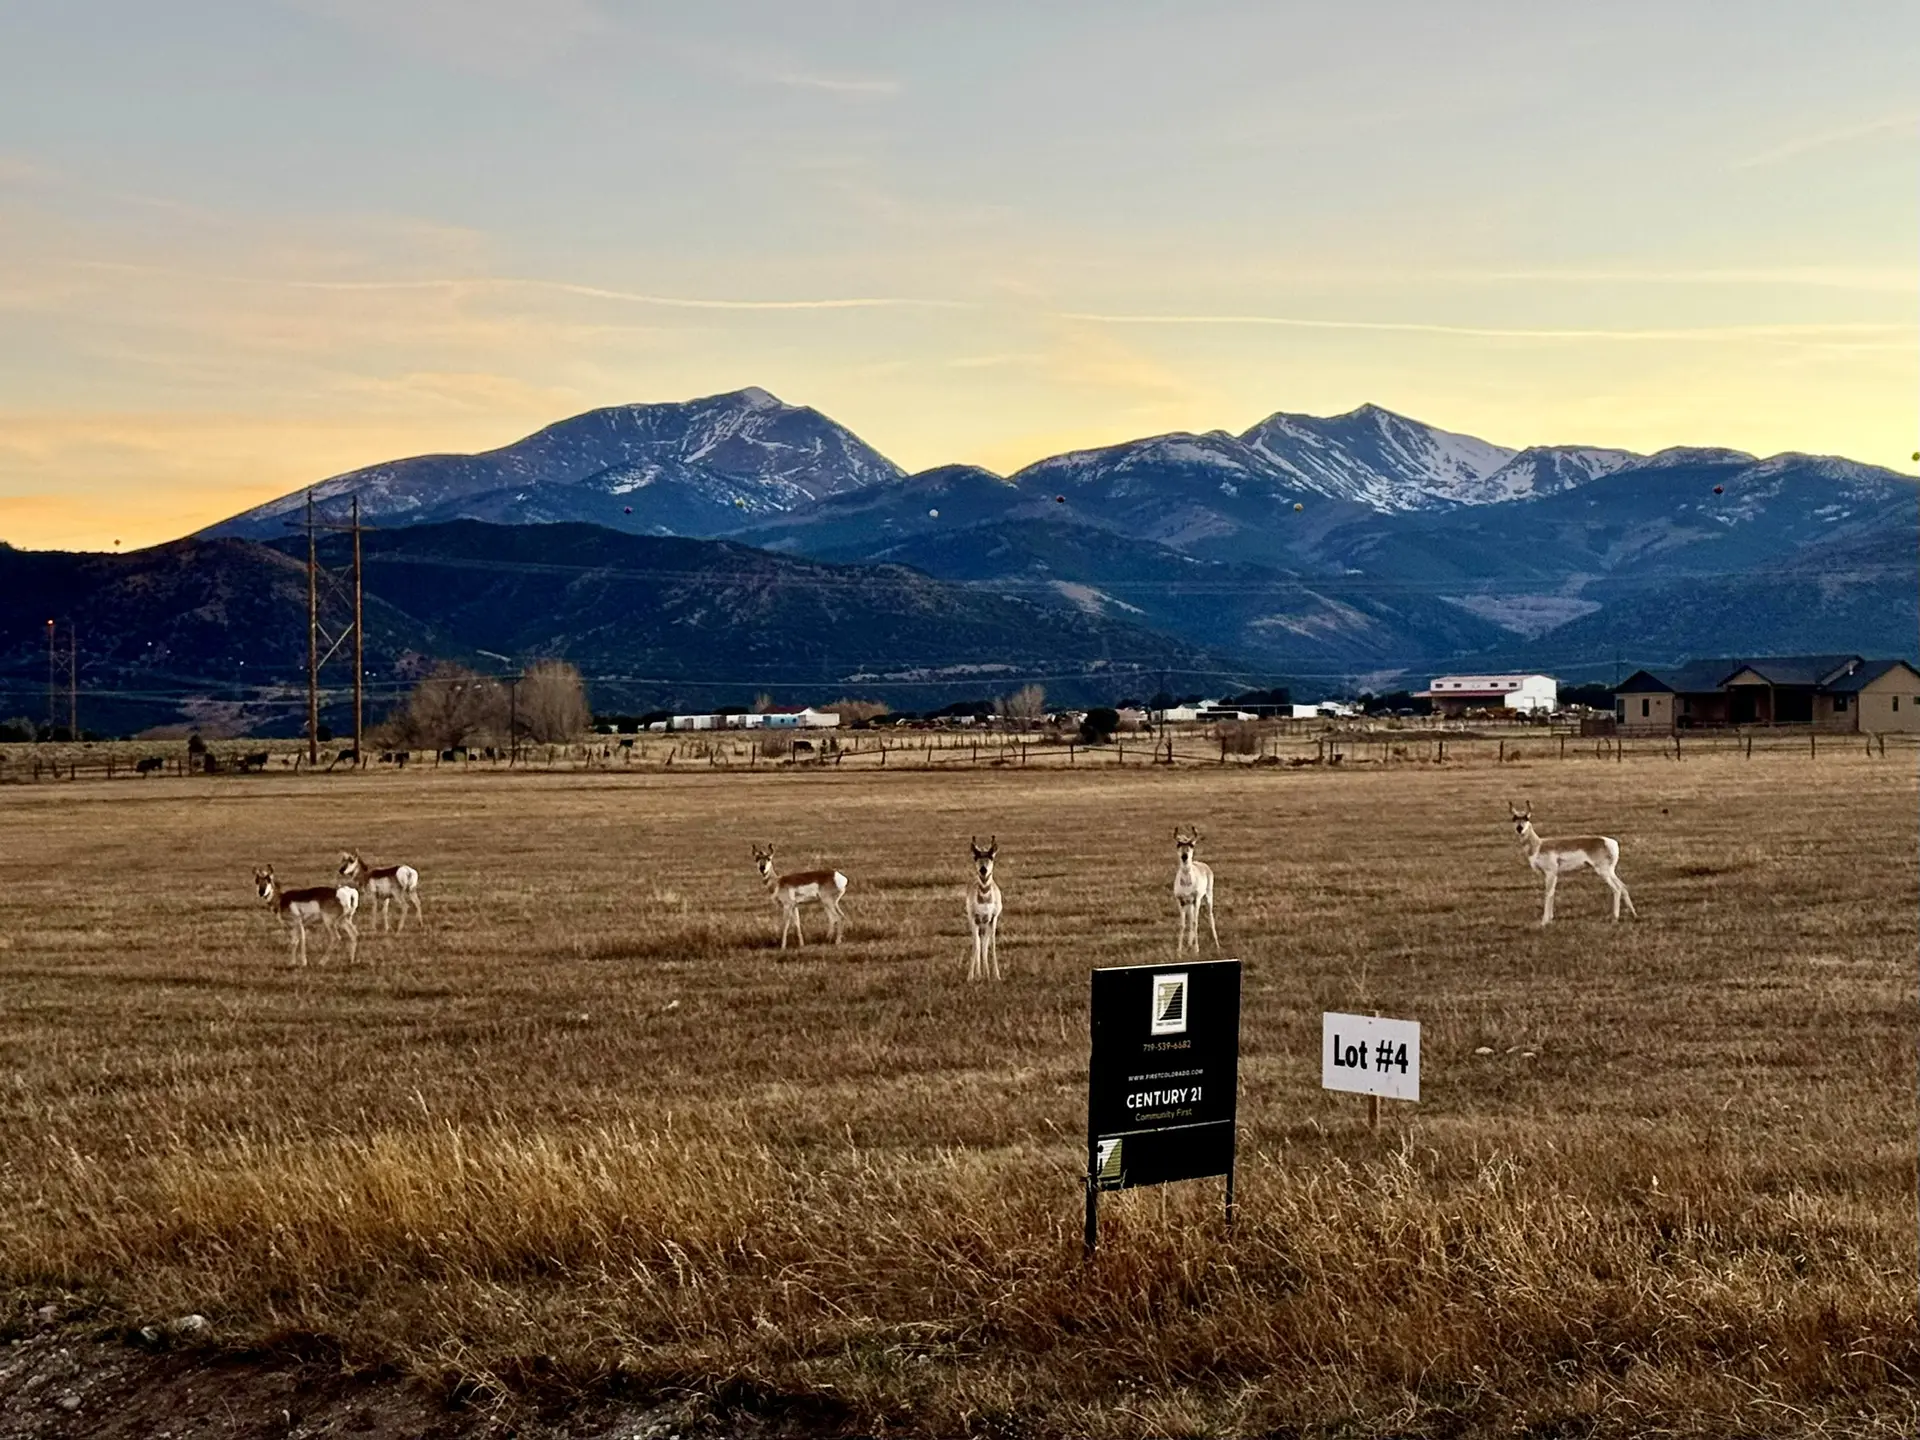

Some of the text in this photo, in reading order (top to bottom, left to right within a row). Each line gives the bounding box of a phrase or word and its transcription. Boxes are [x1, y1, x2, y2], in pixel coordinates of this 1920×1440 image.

[1333, 1034, 1409, 1074] Lot #4
[1126, 1086, 1202, 1109] CENTURY 21
[1135, 1108, 1192, 1121] Community First
